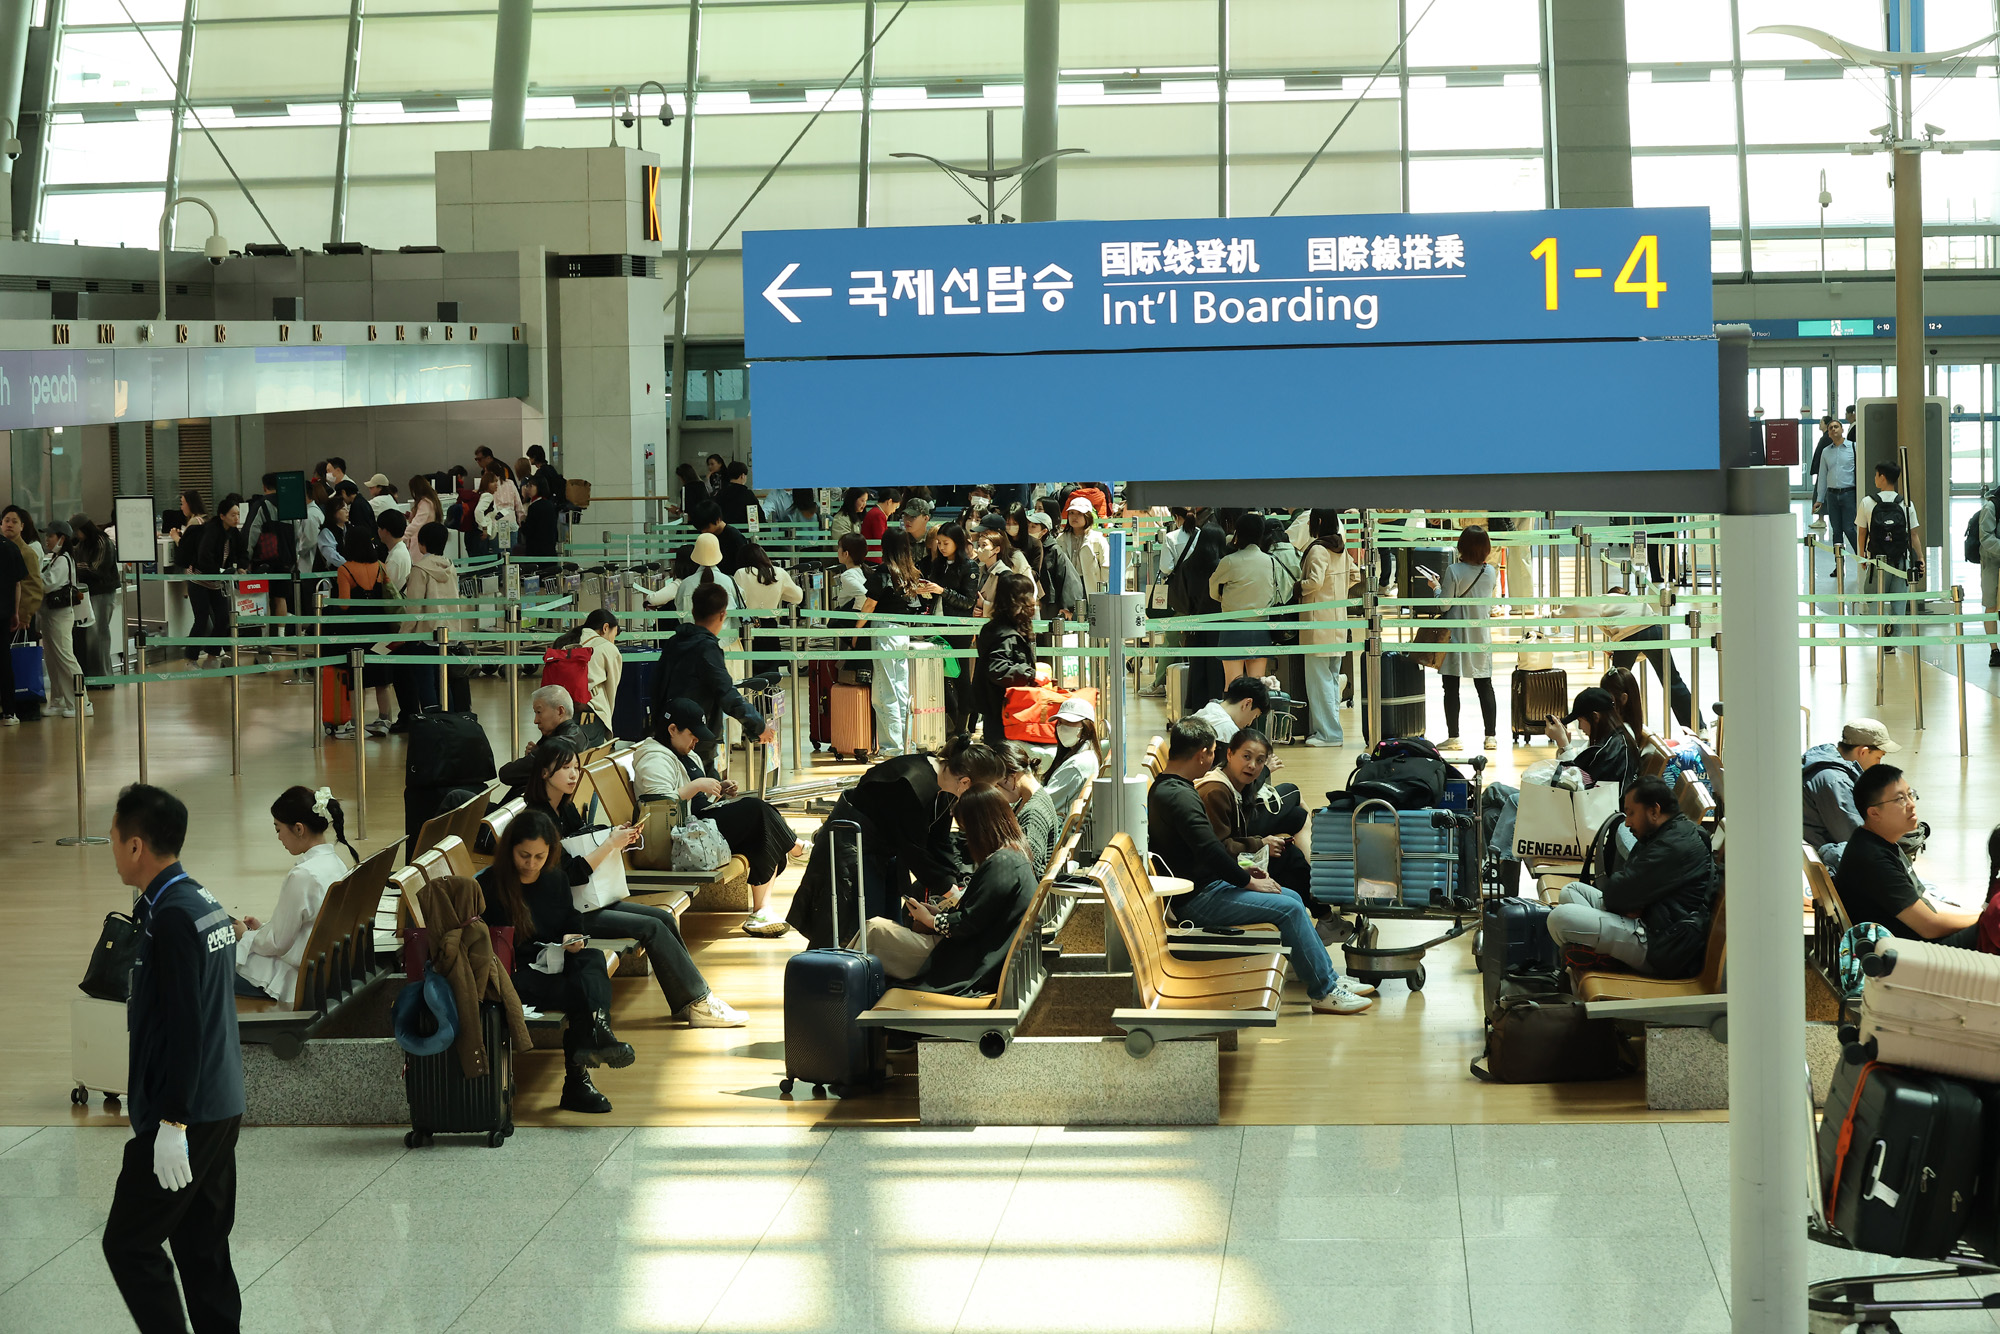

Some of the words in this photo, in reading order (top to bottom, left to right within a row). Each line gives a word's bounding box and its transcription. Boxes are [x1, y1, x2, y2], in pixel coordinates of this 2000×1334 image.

[646, 165, 663, 241] K
[1100, 237, 1261, 278] 国际线登机
[1306, 233, 1466, 273] 国際線搭乗
[1529, 234, 1668, 311] 1-4
[847, 262, 1075, 317] 국제선탑승
[1102, 289, 1178, 326] Int'l
[1192, 286, 1379, 330] Boarding
[54, 323, 71, 345] K11
[98, 323, 116, 344] K10
[177, 323, 189, 344] K9
[215, 323, 227, 343] K8
[1882, 323, 1890, 331] 10
[31, 364, 78, 415] peach
[1516, 839, 1582, 857] GENERAL
